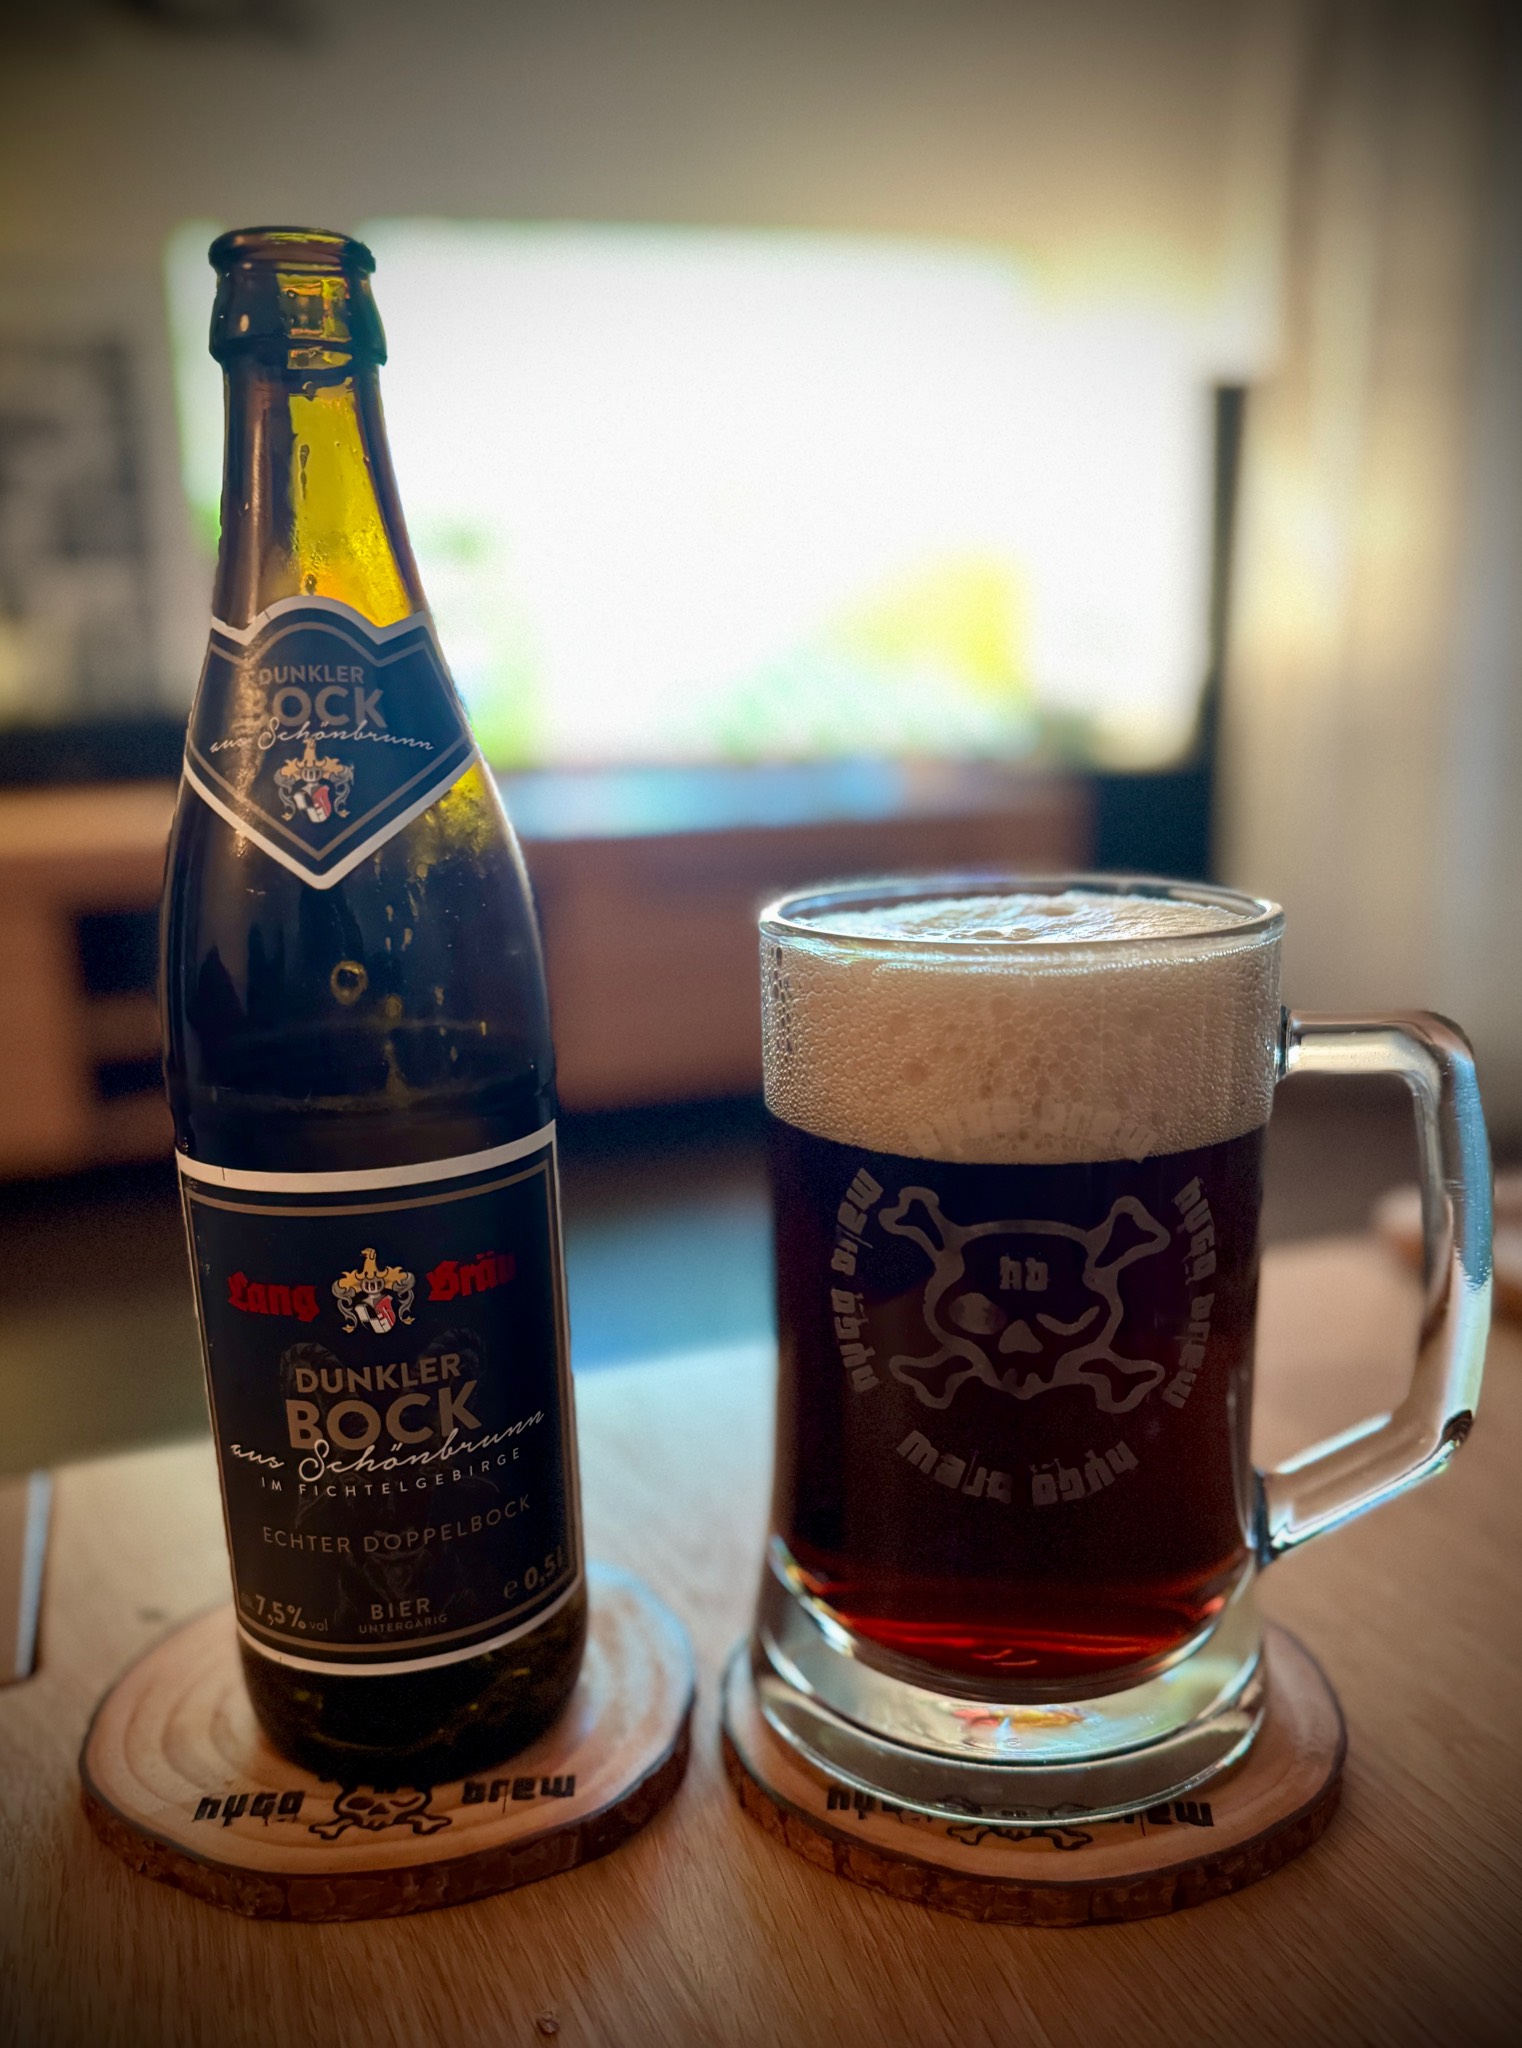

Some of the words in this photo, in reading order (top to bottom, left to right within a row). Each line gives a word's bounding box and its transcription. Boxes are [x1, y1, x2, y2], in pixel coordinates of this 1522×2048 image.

[259, 665, 364, 685] DUNKLER
[257, 717, 434, 751] Schönbrunn
[227, 1271, 320, 1322] Lang
[295, 1352, 462, 1394] DUNKLER
[284, 1379, 483, 1450] BOCK
[230, 1443, 285, 1469] aus
[299, 1410, 545, 1482] Schönbrunn
[261, 1477, 283, 1492] IM
[299, 1447, 521, 1498] FICHTELGEBIRGE
[263, 1526, 351, 1553] ECHTER
[364, 1494, 531, 1552] DOPPELBOCK
[256, 1594, 307, 1630] 7,5%
[370, 1598, 432, 1621] BIER
